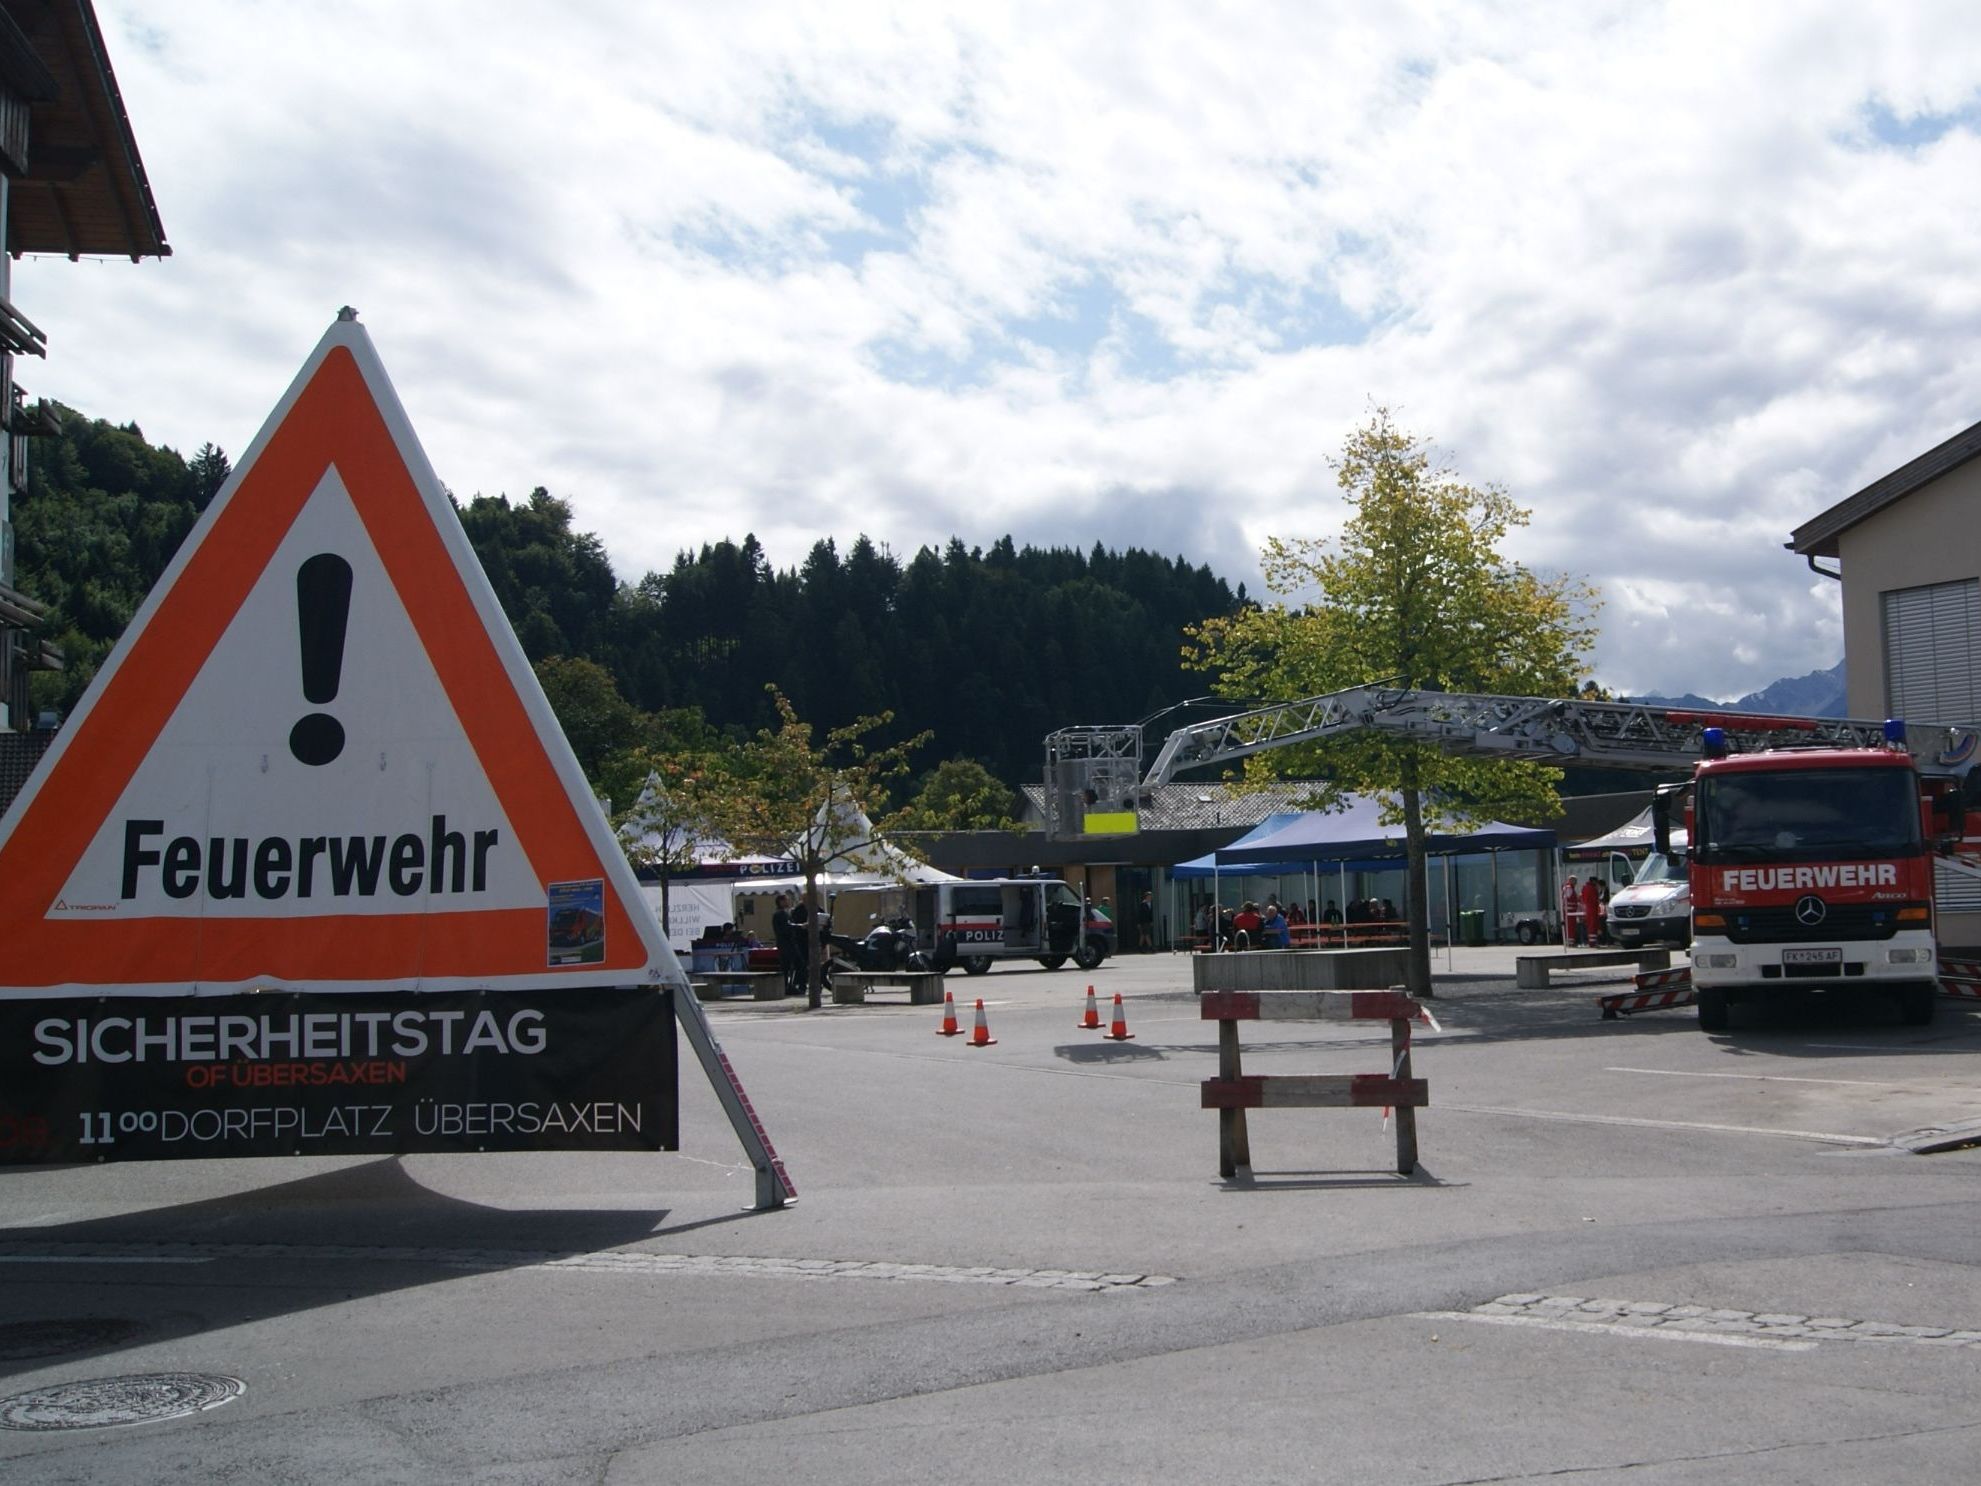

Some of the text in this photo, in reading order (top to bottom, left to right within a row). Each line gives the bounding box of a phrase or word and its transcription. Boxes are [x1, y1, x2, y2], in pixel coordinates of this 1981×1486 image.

[121, 814, 498, 900] Feuerwehr
[740, 862, 800, 874] POLIZEI
[1723, 864, 1897, 891] FEUERWEHR
[32, 1008, 547, 1065] SICHERHEITSTAG
[187, 1060, 406, 1089] OF ÜBERSAXEN
[162, 1106, 393, 1141] DORFPLATZ
[415, 1098, 641, 1135] ÜBERSAXEN
